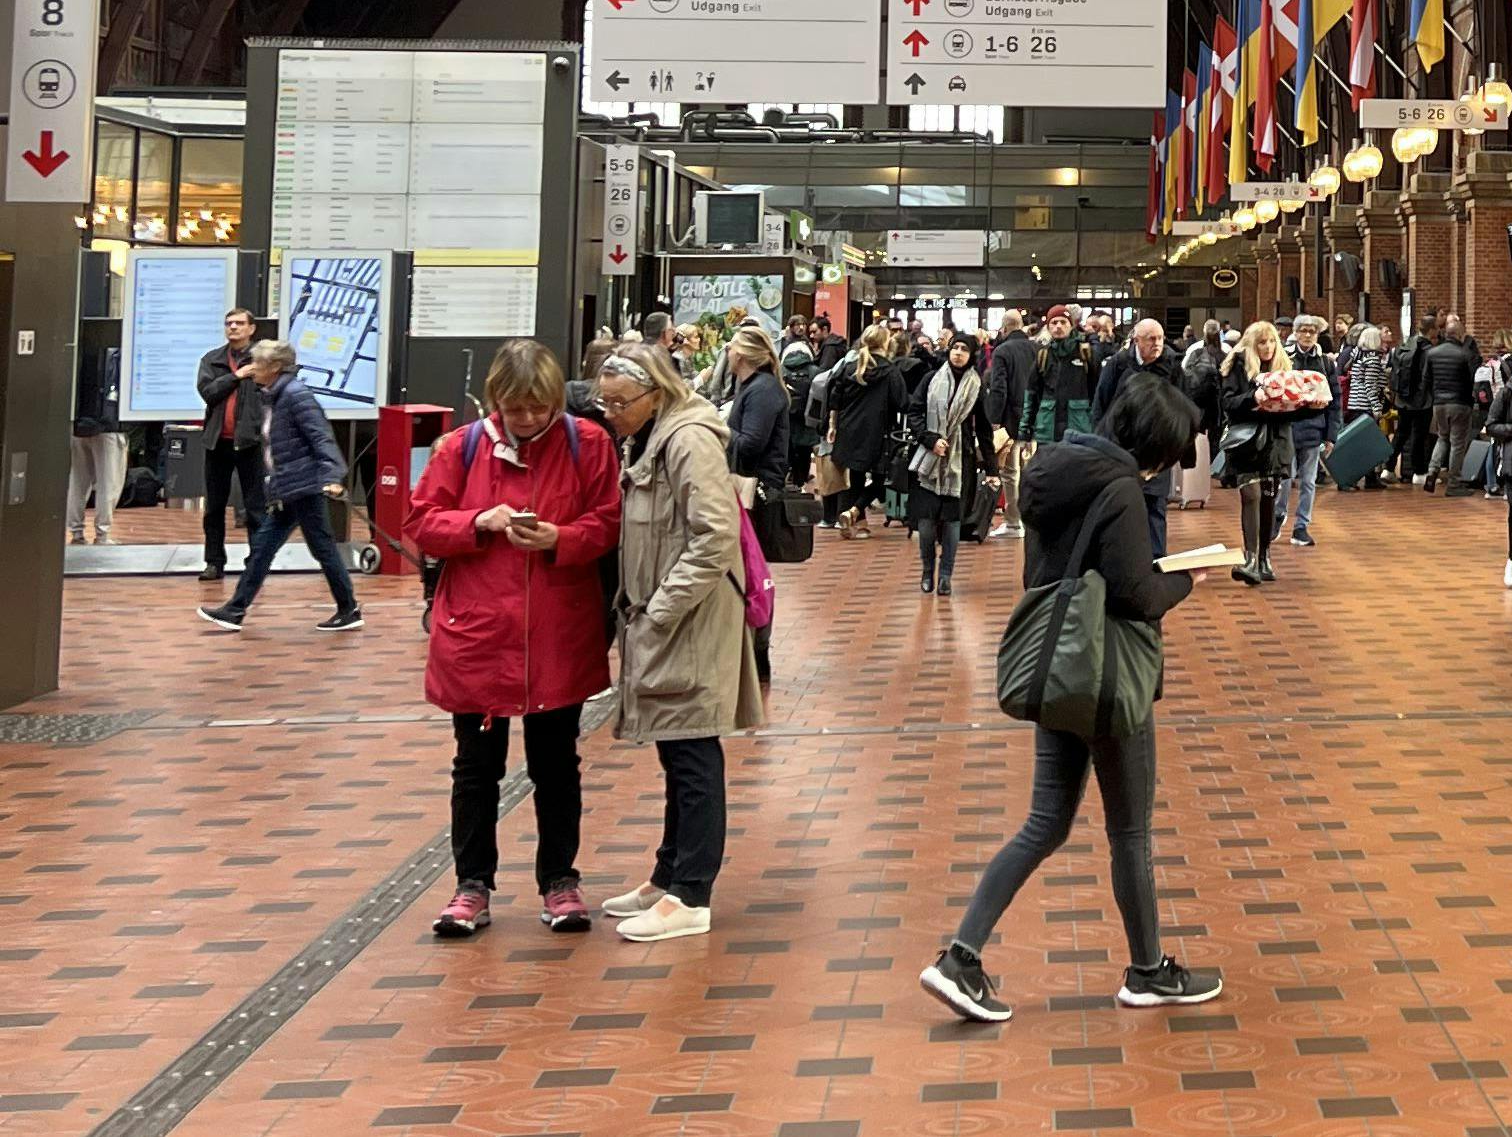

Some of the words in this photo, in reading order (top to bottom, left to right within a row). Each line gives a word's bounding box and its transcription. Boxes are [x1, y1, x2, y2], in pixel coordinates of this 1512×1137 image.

[691, 1, 739, 13] Udgang
[743, 3, 762, 12] Exit
[985, 6, 1032, 18] Udgang
[1035, 8, 1053, 17] Exit
[985, 35, 1019, 53] 1-6
[1030, 36, 1057, 53] 26
[1398, 107, 1421, 120] 5-6
[1427, 108, 1445, 120] 26
[609, 158, 635, 172] 5-6
[610, 188, 632, 201] 26
[765, 223, 782, 232] 3-4
[679, 281, 747, 297] CHIPOTLE
[680, 297, 722, 313] SALAT
